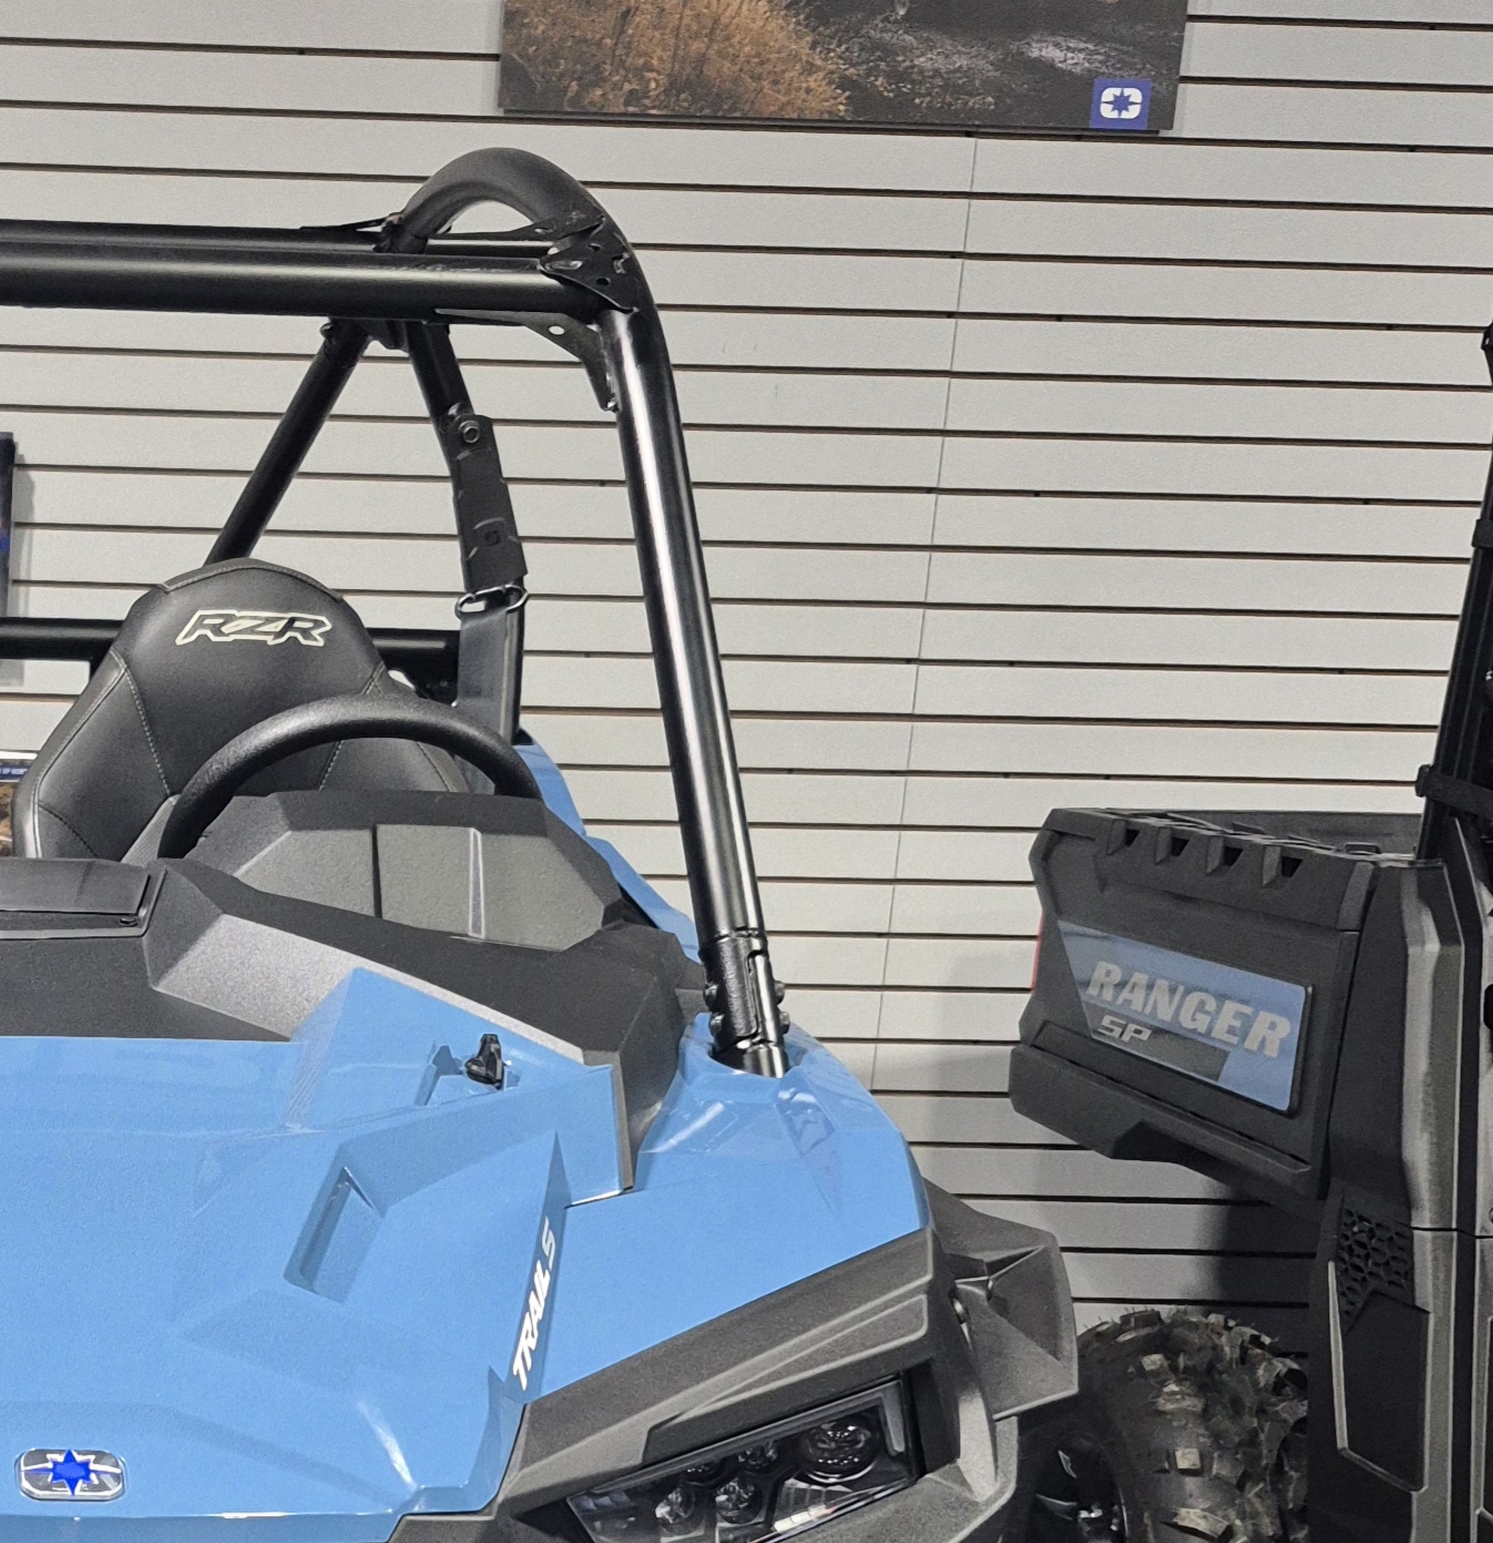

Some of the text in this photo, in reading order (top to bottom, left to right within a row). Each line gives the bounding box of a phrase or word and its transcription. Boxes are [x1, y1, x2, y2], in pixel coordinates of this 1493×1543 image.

[175, 609, 332, 647] RZR
[1087, 960, 1291, 1058] RANGER
[1097, 1015, 1152, 1043] SP
